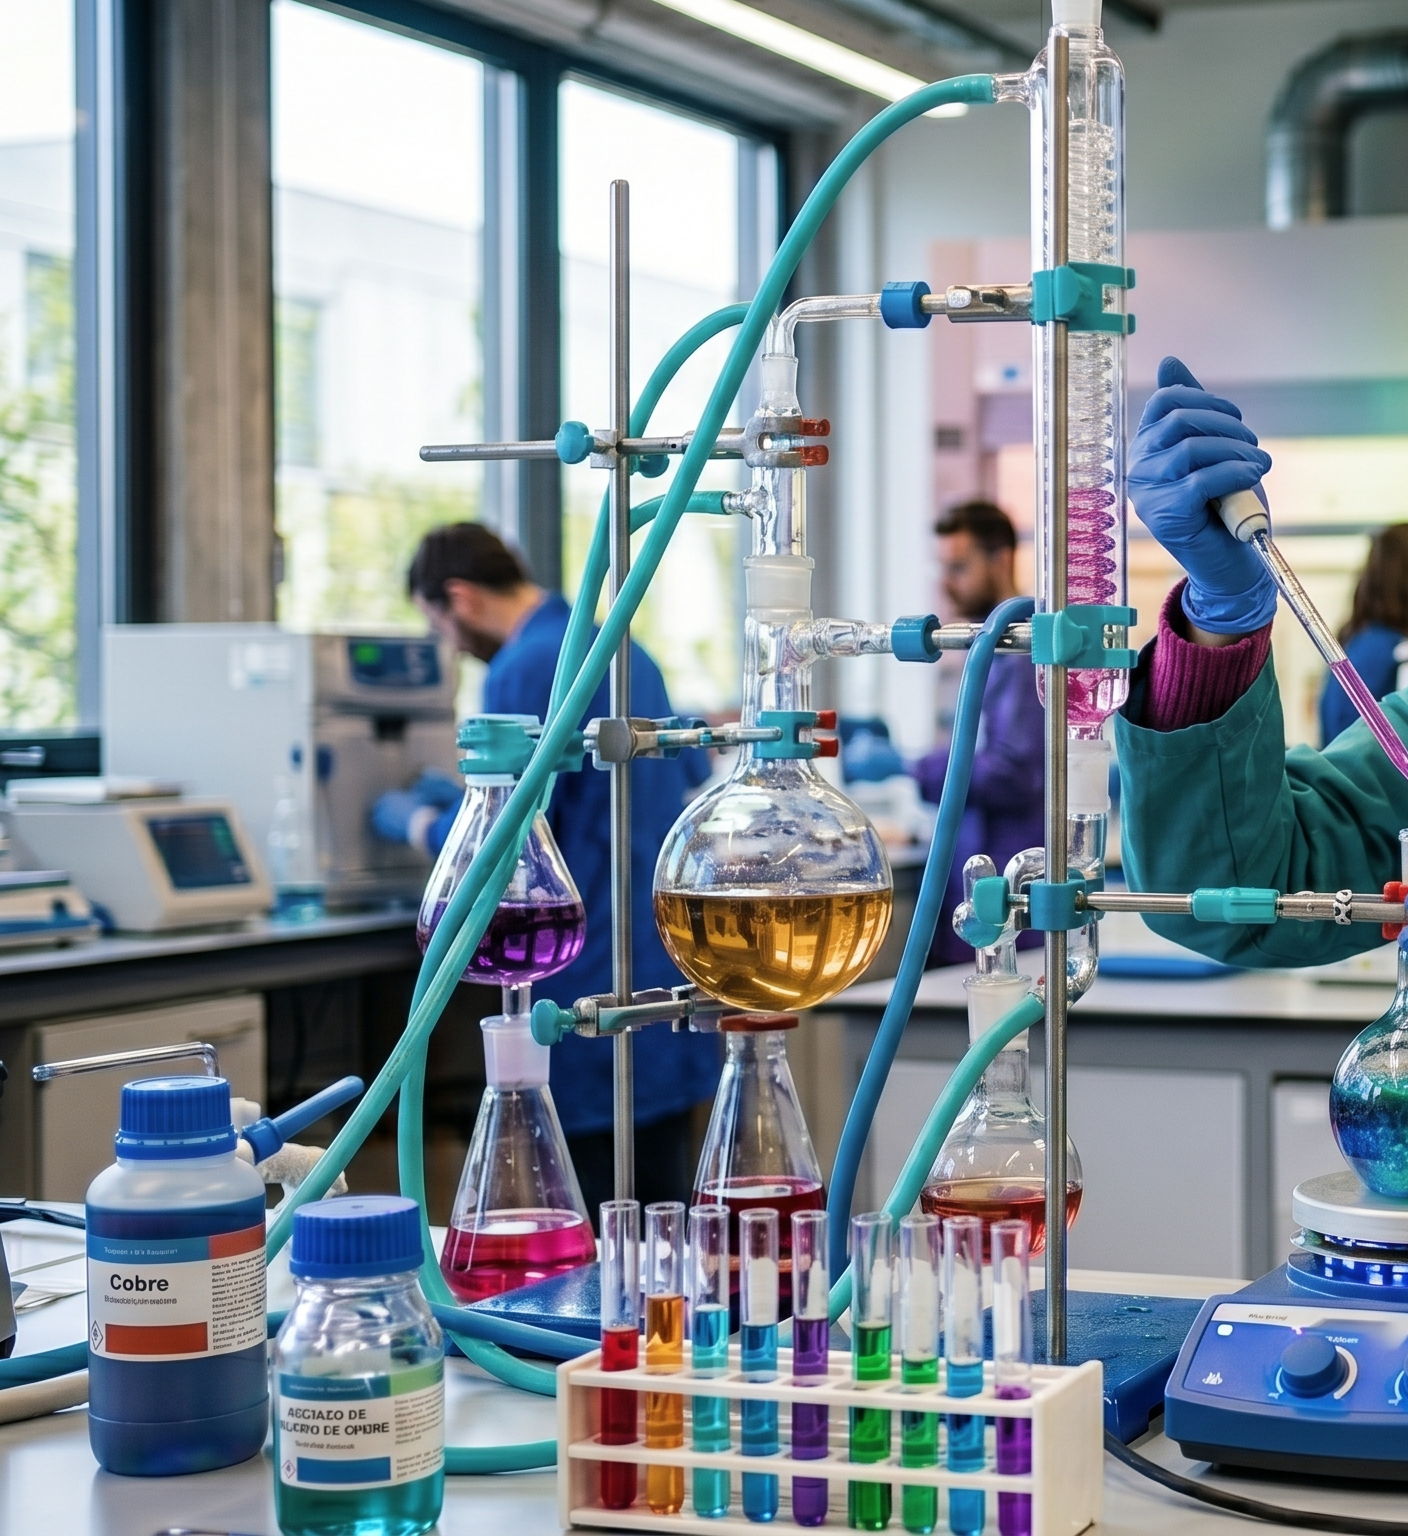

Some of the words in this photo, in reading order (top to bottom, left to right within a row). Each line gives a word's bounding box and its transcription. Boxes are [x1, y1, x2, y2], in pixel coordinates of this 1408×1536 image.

[110, 1273, 169, 1292] Cobre
[348, 1408, 367, 1420] DE
[323, 1425, 340, 1436] DE
